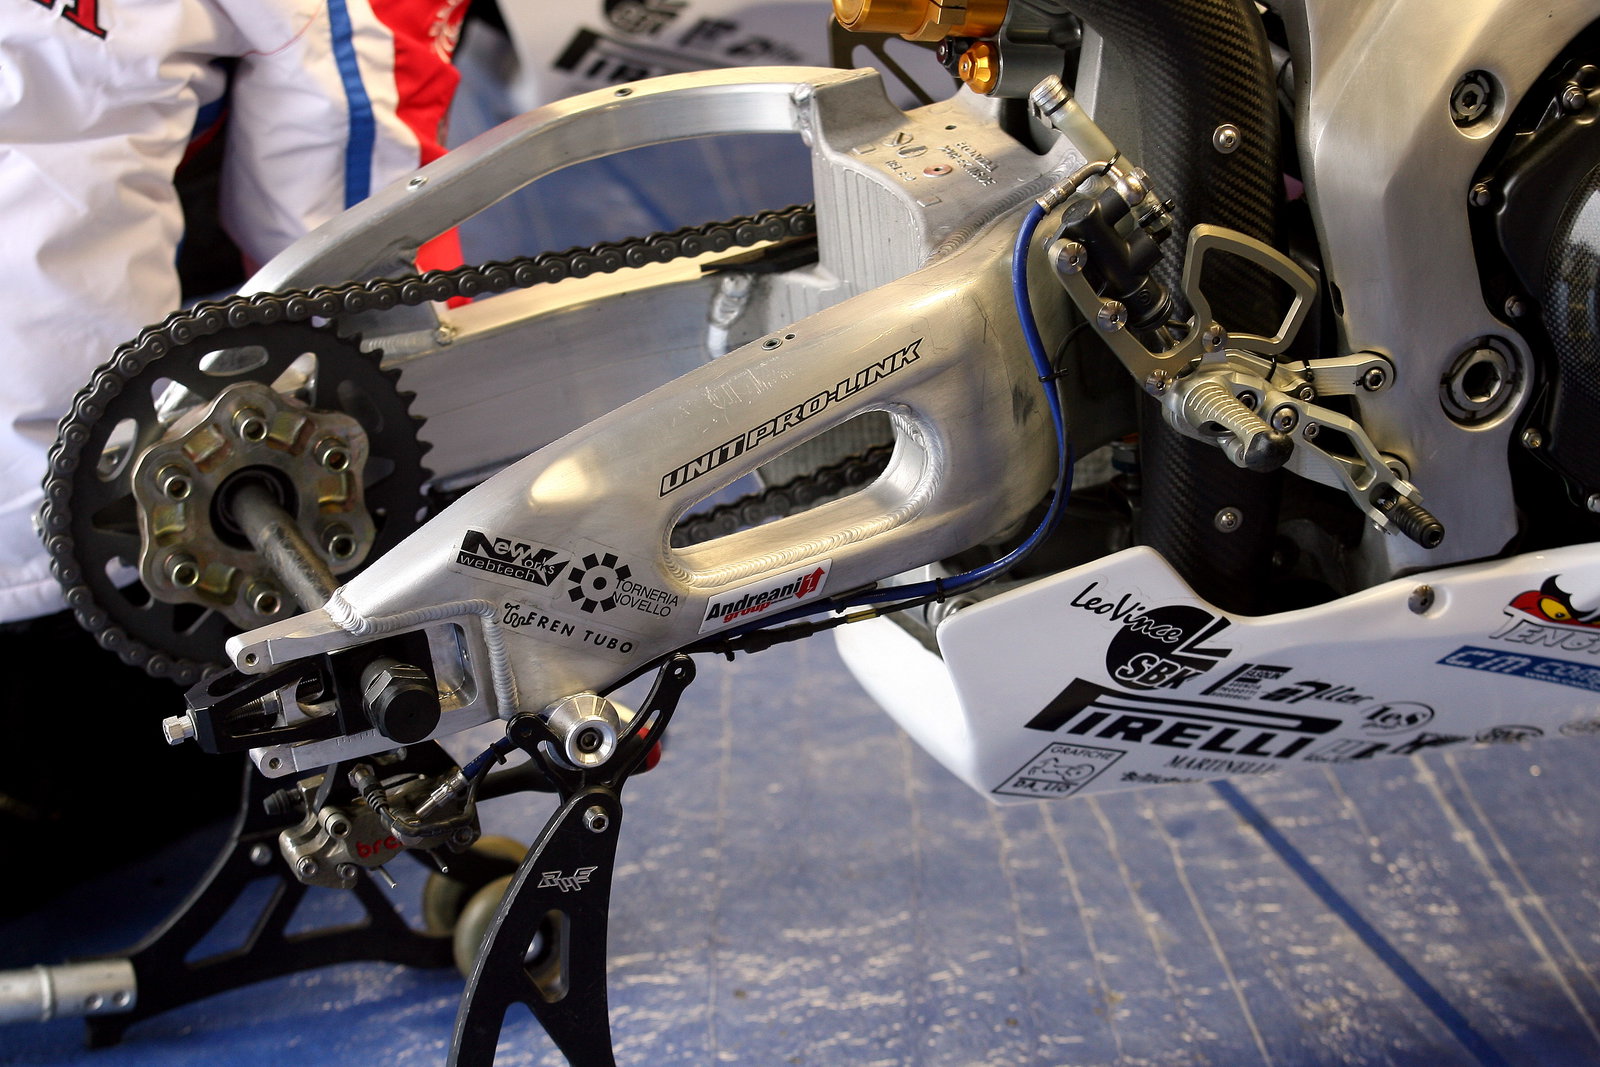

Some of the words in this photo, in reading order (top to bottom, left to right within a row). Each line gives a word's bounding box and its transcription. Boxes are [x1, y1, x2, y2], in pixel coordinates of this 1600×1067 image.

[659, 433, 747, 498] UNIT
[745, 337, 925, 452] PRO-LINK
[459, 554, 536, 583] webtech
[612, 591, 672, 617] NOVELLO
[616, 577, 679, 607] TORNERIA
[705, 576, 803, 621] Andreani
[722, 601, 773, 624] group
[1069, 581, 1183, 644] LeoVince
[583, 629, 634, 653] TUBO
[1115, 652, 1203, 691] SBK
[1023, 677, 1343, 759] PIRELLI
